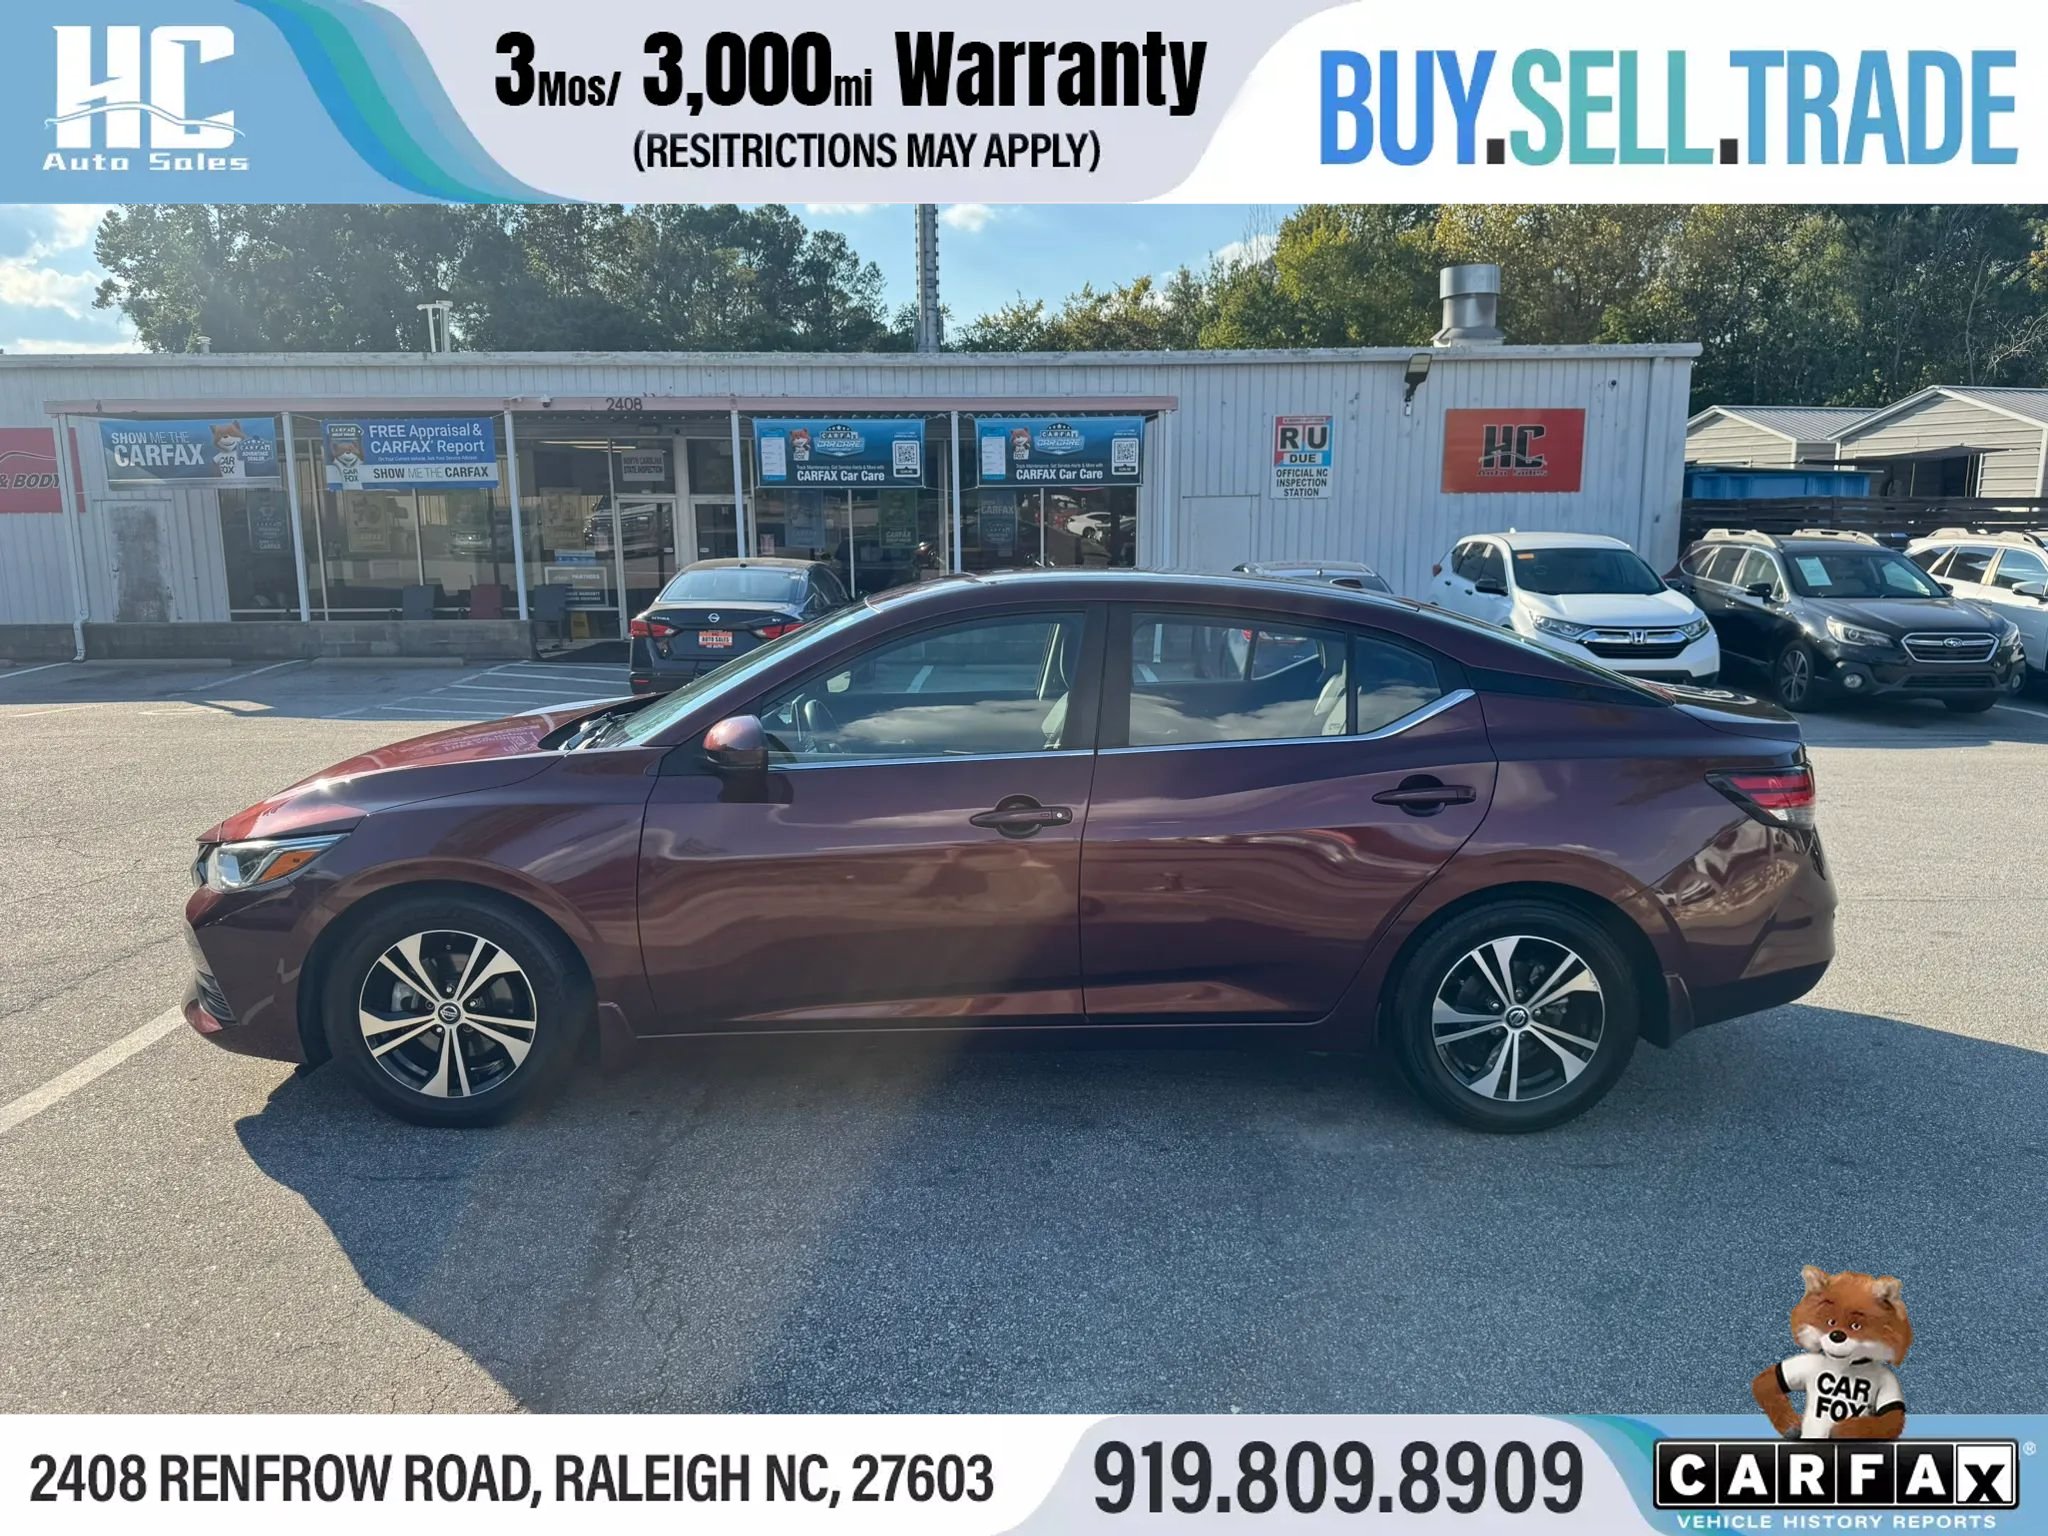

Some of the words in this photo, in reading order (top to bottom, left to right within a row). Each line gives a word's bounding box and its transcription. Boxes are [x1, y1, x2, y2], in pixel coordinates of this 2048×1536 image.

[606, 398, 643, 411] 2408
[111, 432, 148, 444] SHOW
[150, 432, 167, 443] ME
[169, 431, 190, 443] THE
[369, 425, 406, 438] FREE
[409, 424, 470, 441] Appraisal
[472, 424, 482, 437] &
[438, 439, 485, 455] Report
[1482, 424, 1547, 469] HC
[114, 444, 205, 467] CARFAX
[1289, 454, 1316, 463] DUE
[374, 468, 405, 479] SHOW
[408, 468, 420, 478] ME
[424, 467, 441, 478] THE
[445, 466, 489, 478] CARFAX
[797, 470, 838, 481] CARFAX
[841, 470, 858, 481] Car
[861, 470, 885, 481] Care
[1016, 469, 1057, 480] CARFAX
[1059, 469, 1077, 479] Car
[1080, 469, 1103, 479] Care
[1276, 469, 1314, 478] OFFICIAL
[1316, 469, 1328, 477] NC
[1276, 478, 1327, 487] INSPECTION
[1284, 488, 1319, 497] STATION
